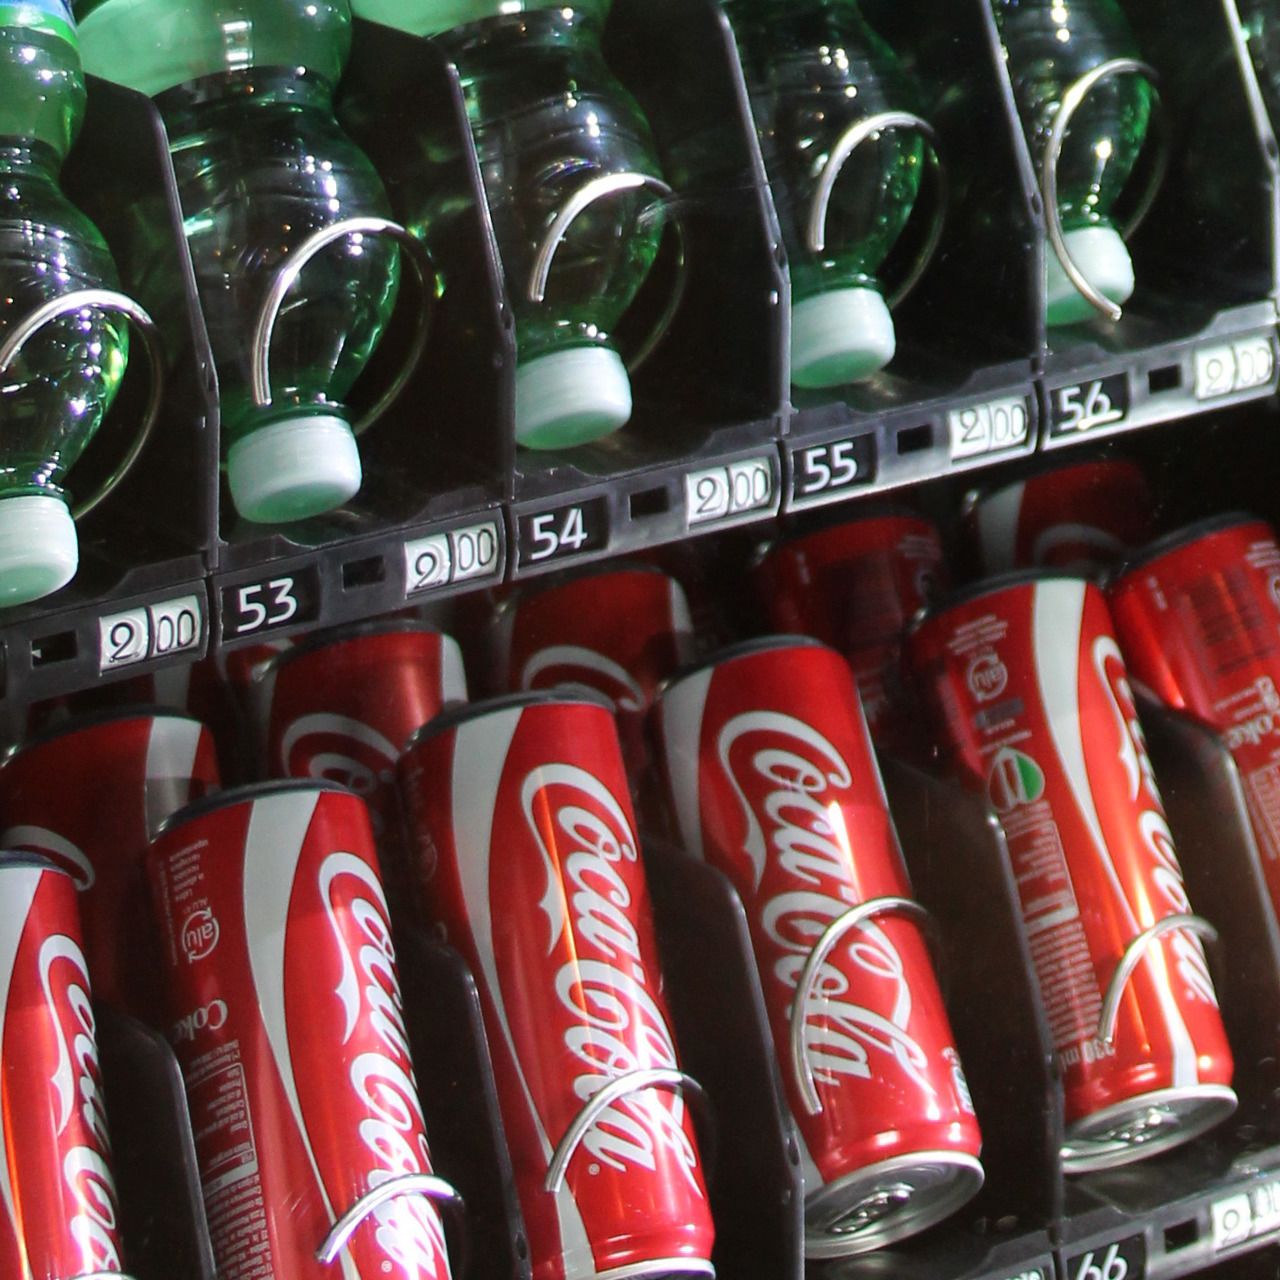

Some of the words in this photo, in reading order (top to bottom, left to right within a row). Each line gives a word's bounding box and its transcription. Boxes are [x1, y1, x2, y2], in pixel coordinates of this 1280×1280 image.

[1058, 381, 1113, 431] 56
[803, 440, 858, 493] 55
[530, 507, 588, 561] 54
[236, 577, 298, 633] 53
[716, 710, 937, 1099] Coca-Cola
[185, 920, 216, 952] alu
[520, 762, 705, 1200] Coca-Cola
[170, 997, 230, 1042] Coke
[1075, 1243, 1129, 1280] 66
